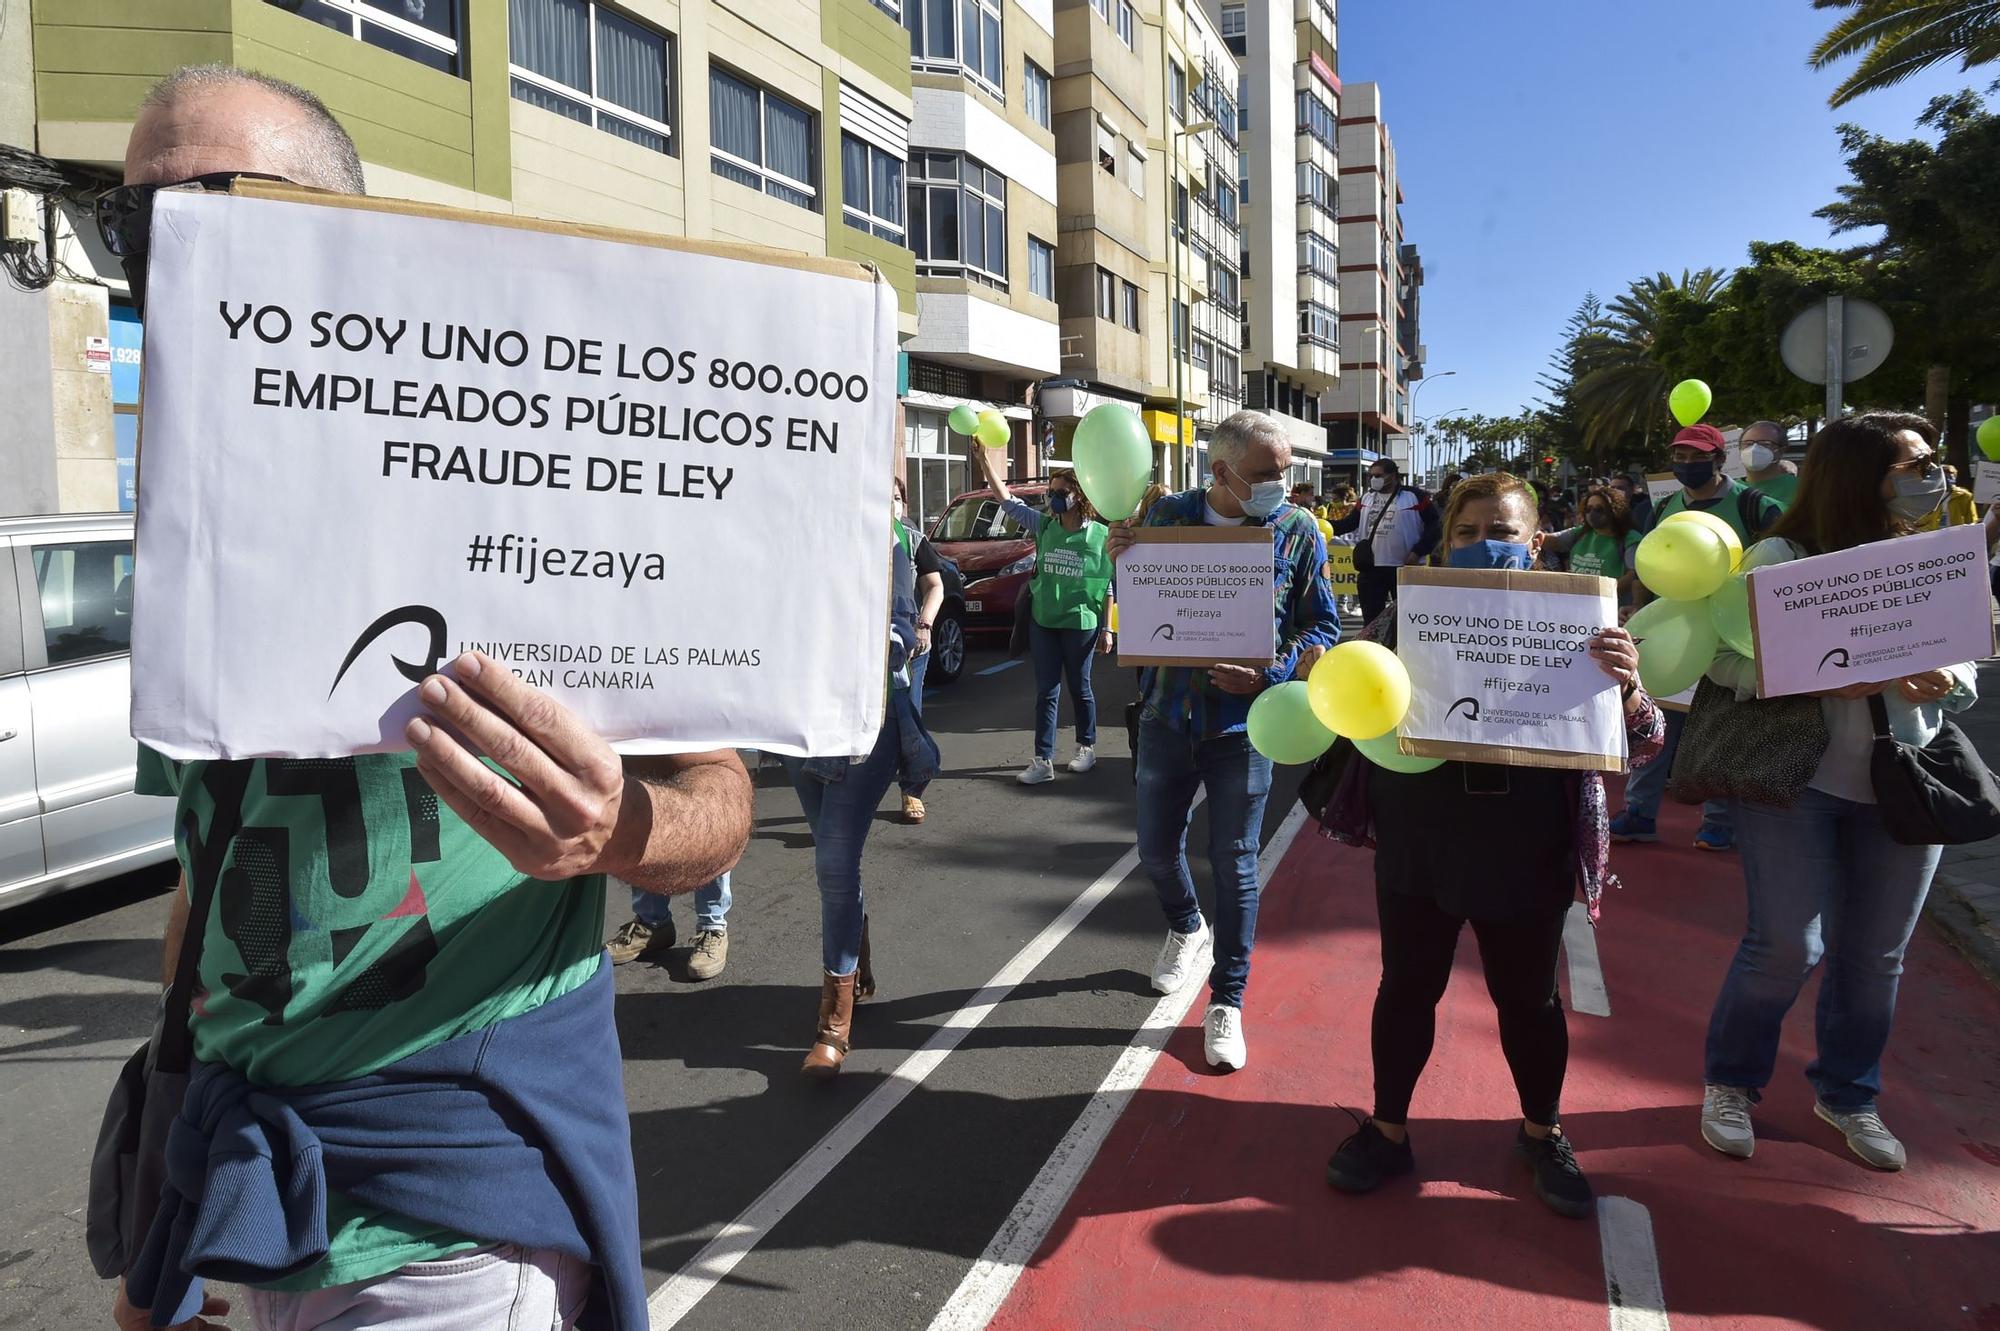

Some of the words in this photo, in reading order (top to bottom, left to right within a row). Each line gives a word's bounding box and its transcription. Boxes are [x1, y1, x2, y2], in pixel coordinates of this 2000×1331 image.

[219, 302, 291, 344] YO
[310, 311, 406, 354] SOY
[421, 323, 529, 367] UNO
[544, 336, 601, 374] DE
[617, 345, 695, 384] LOS
[709, 359, 868, 402] 800.000
[253, 369, 550, 428] EMPLEADOS
[566, 394, 772, 447] PÚBLICOS
[786, 419, 838, 453] EN
[382, 442, 571, 489] FRAUDE
[587, 459, 642, 494] DE
[657, 464, 734, 499] LEY
[467, 535, 665, 587] #fijezaya
[1125, 564, 1140, 573] YO
[1143, 564, 1162, 573] SOY
[1165, 564, 1188, 573] UNO
[1192, 565, 1204, 573] DE
[1208, 565, 1227, 574] LOS
[1229, 566, 1272, 574] 800.000
[1338, 556, 1351, 564] añ
[1044, 564, 1053, 573] EN
[1056, 565, 1084, 577] LUCHA
[1330, 573, 1357, 584] EUR
[1773, 586, 1793, 598] YO
[1797, 580, 1824, 595] SOY
[1828, 573, 1859, 588] UNO
[1864, 569, 1883, 581] DE
[1886, 562, 1914, 578] LOS
[1918, 552, 1976, 571] 800.000
[1132, 577, 1194, 586] EMPLEADOS
[1196, 576, 1247, 587] PÚBLICOS
[1250, 578, 1264, 587] EN
[1784, 589, 1869, 611] EMPLEADOS
[1873, 572, 1943, 594] PÚBLICOS
[1946, 568, 1967, 581] EN
[1158, 590, 1200, 599] FRAUDE
[1202, 590, 1215, 599] DE
[1218, 590, 1238, 599] LEY
[1176, 608, 1222, 620] #fijezaya
[1821, 602, 1879, 619] FRAUDE
[1883, 596, 1902, 609] DE
[1906, 591, 1932, 605] LEY
[1408, 614, 1429, 625] YO
[1434, 614, 1462, 627] SOY
[1466, 617, 1500, 629] UNO
[1504, 619, 1524, 631] DE
[1528, 620, 1555, 633] LOS
[1560, 624, 1600, 636] 800.0
[1850, 619, 1913, 638] #fijezaya
[1418, 631, 1508, 647] EMPLEADOS
[1513, 636, 1585, 653] PÚBLICOS
[1852, 648, 1896, 660] UNIVERSIDAD
[1908, 642, 1920, 650] LAS
[1922, 637, 1947, 648] PALMAS
[460, 642, 602, 663] UNIVERSIDAD
[611, 646, 635, 664] DE
[644, 648, 679, 666] LAS
[687, 648, 761, 668] PALMAS
[1456, 650, 1516, 665] FRAUDE
[1520, 654, 1541, 667] DE
[1545, 657, 1573, 669] LEY
[1864, 657, 1883, 665] GRAN
[1884, 652, 1913, 662] CANARIA
[512, 669, 553, 688] RAN
[564, 670, 655, 690] CANARIA
[1484, 677, 1550, 694] #fijezaya
[1482, 708, 1530, 718] UNIVERSIDAD
[1544, 712, 1557, 720] LAS
[1559, 714, 1587, 723] PALMAS
[1494, 717, 1515, 725] GRAN
[1517, 718, 1548, 727] CANARIA
